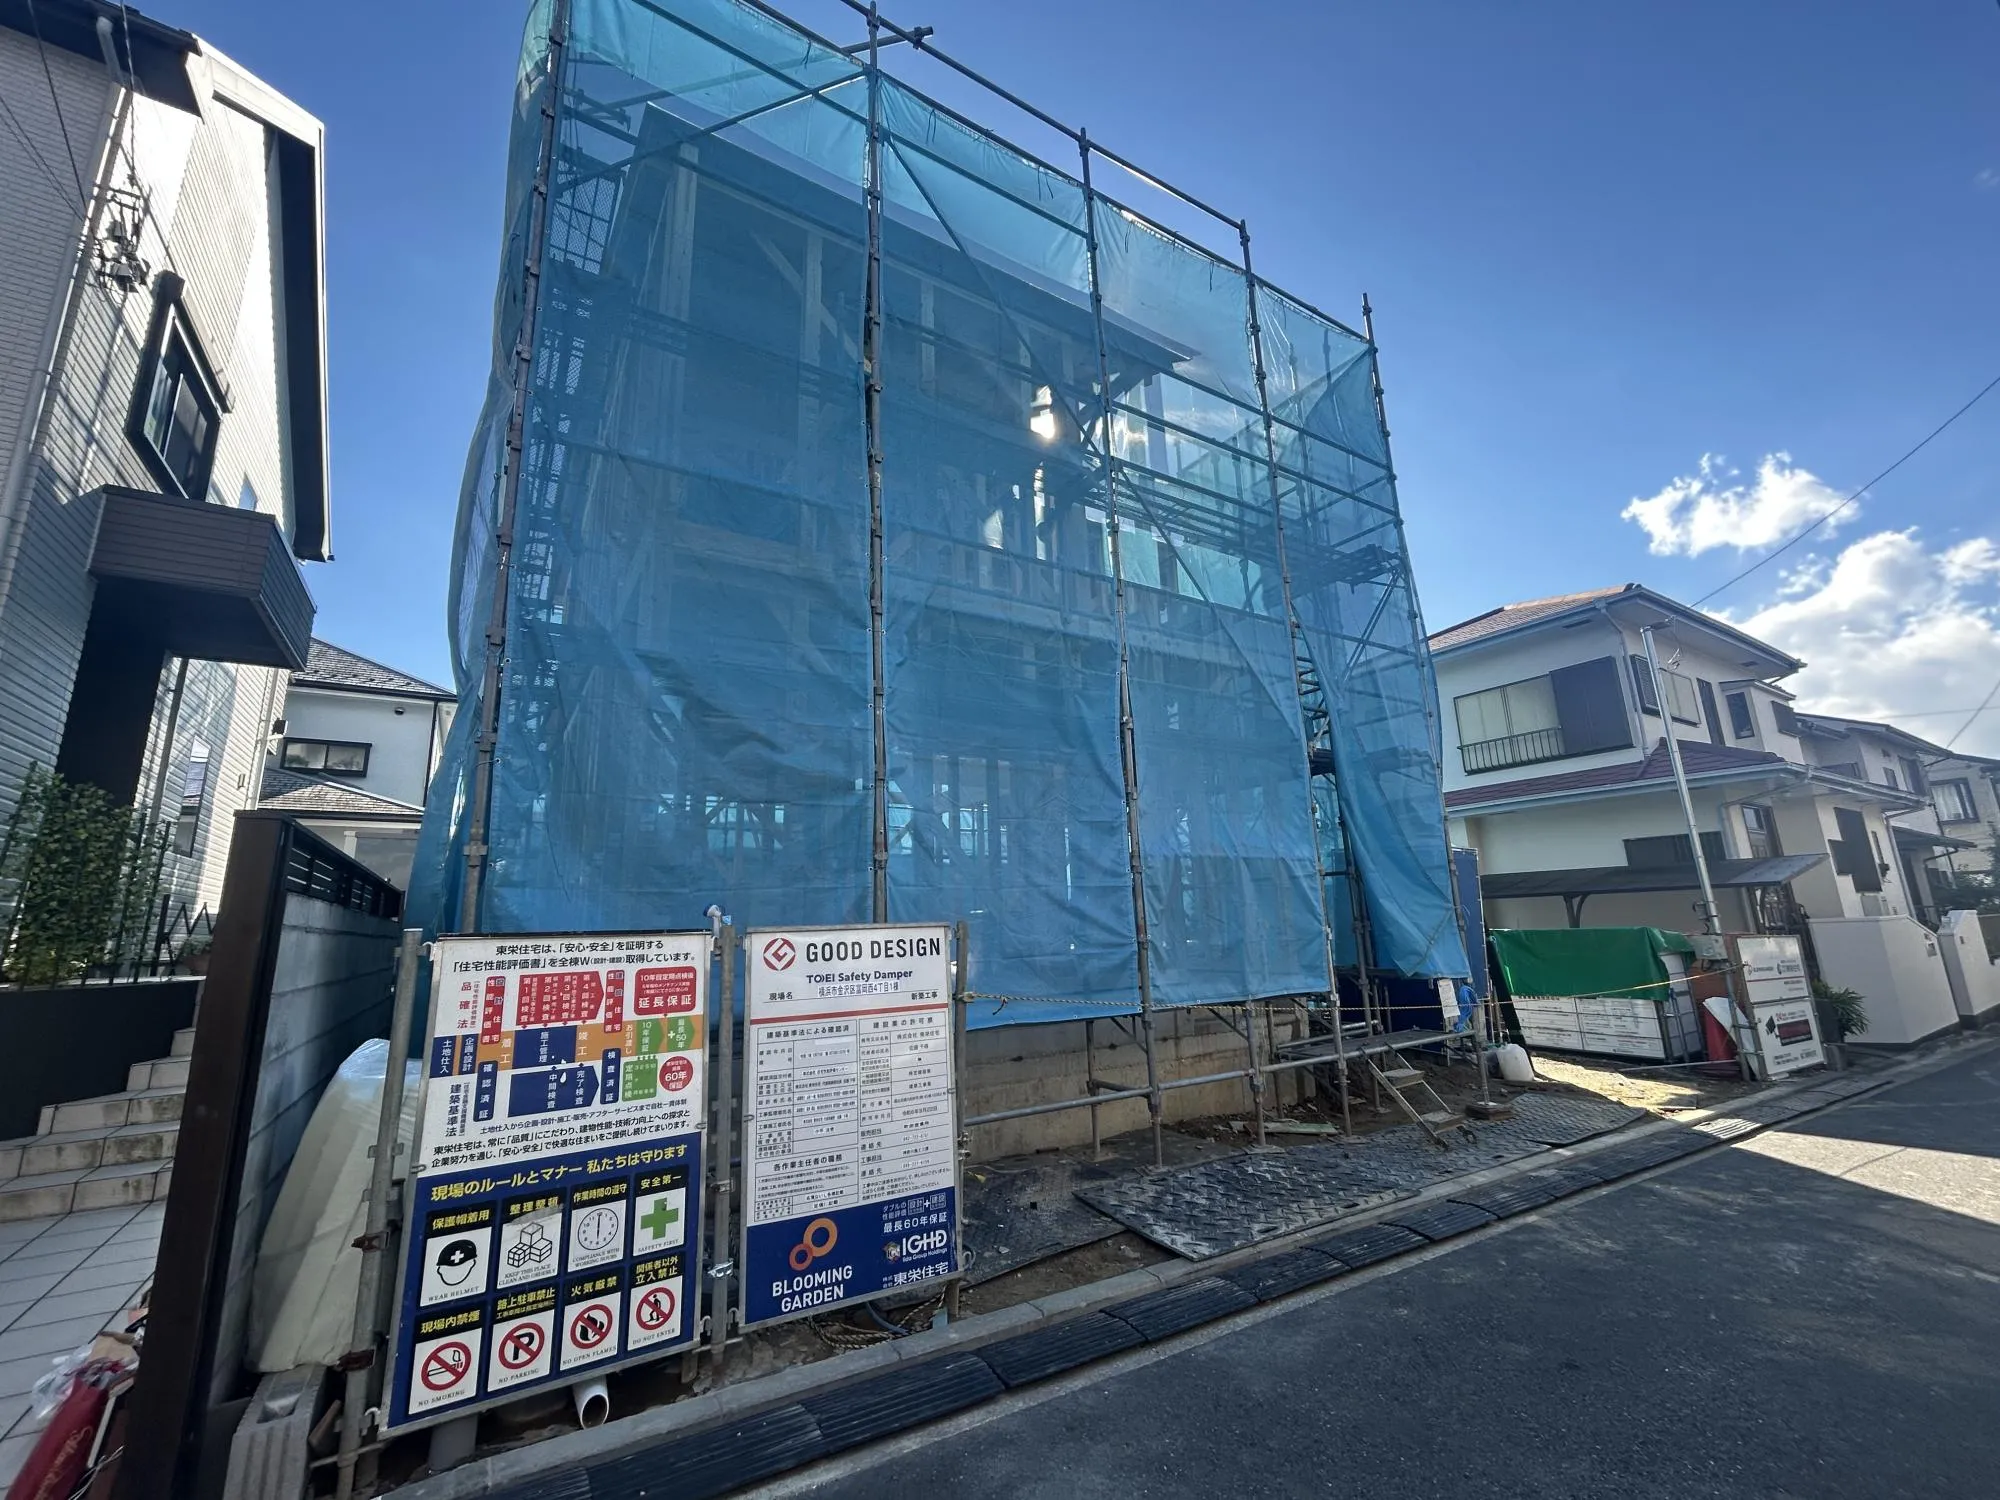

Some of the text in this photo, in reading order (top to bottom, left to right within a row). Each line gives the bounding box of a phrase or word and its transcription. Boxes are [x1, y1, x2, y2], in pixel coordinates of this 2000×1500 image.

[806, 937, 941, 962] GOOD DESIGN
[838, 971, 871, 983] Safety
[874, 969, 913, 981] Damper
[638, 994, 692, 1009] 延長保証
[768, 991, 938, 1001] 現場名 新築工事
[439, 1040, 453, 1074] 土地仕入
[575, 1070, 585, 1105] 完了検査
[605, 1050, 616, 1102] 検査済証
[664, 1071, 688, 1082] 60年
[479, 1063, 493, 1119] 確認済証
[547, 1074, 557, 1109] 中間検査
[445, 1083, 461, 1137] 建築基準法
[430, 1144, 688, 1201] 現場のルールとマナー 私たちは守ります
[640, 1174, 682, 1189] 安全第一
[883, 1201, 907, 1213] ダブルの
[432, 1210, 490, 1231] 保護帽着用
[883, 1211, 948, 1234] 最長60年保証
[636, 1256, 679, 1274] 関係者以外
[912, 1252, 928, 1260] Group
[635, 1267, 678, 1285] 立入禁止
[772, 1265, 853, 1297] BLOOMING
[893, 1261, 949, 1287] 東栄住宅
[571, 1276, 617, 1297] 火気厳禁
[781, 1283, 844, 1313] GARDEN
[497, 1287, 556, 1311] 路上駐車禁止
[420, 1309, 480, 1334] 現場内禁煙
